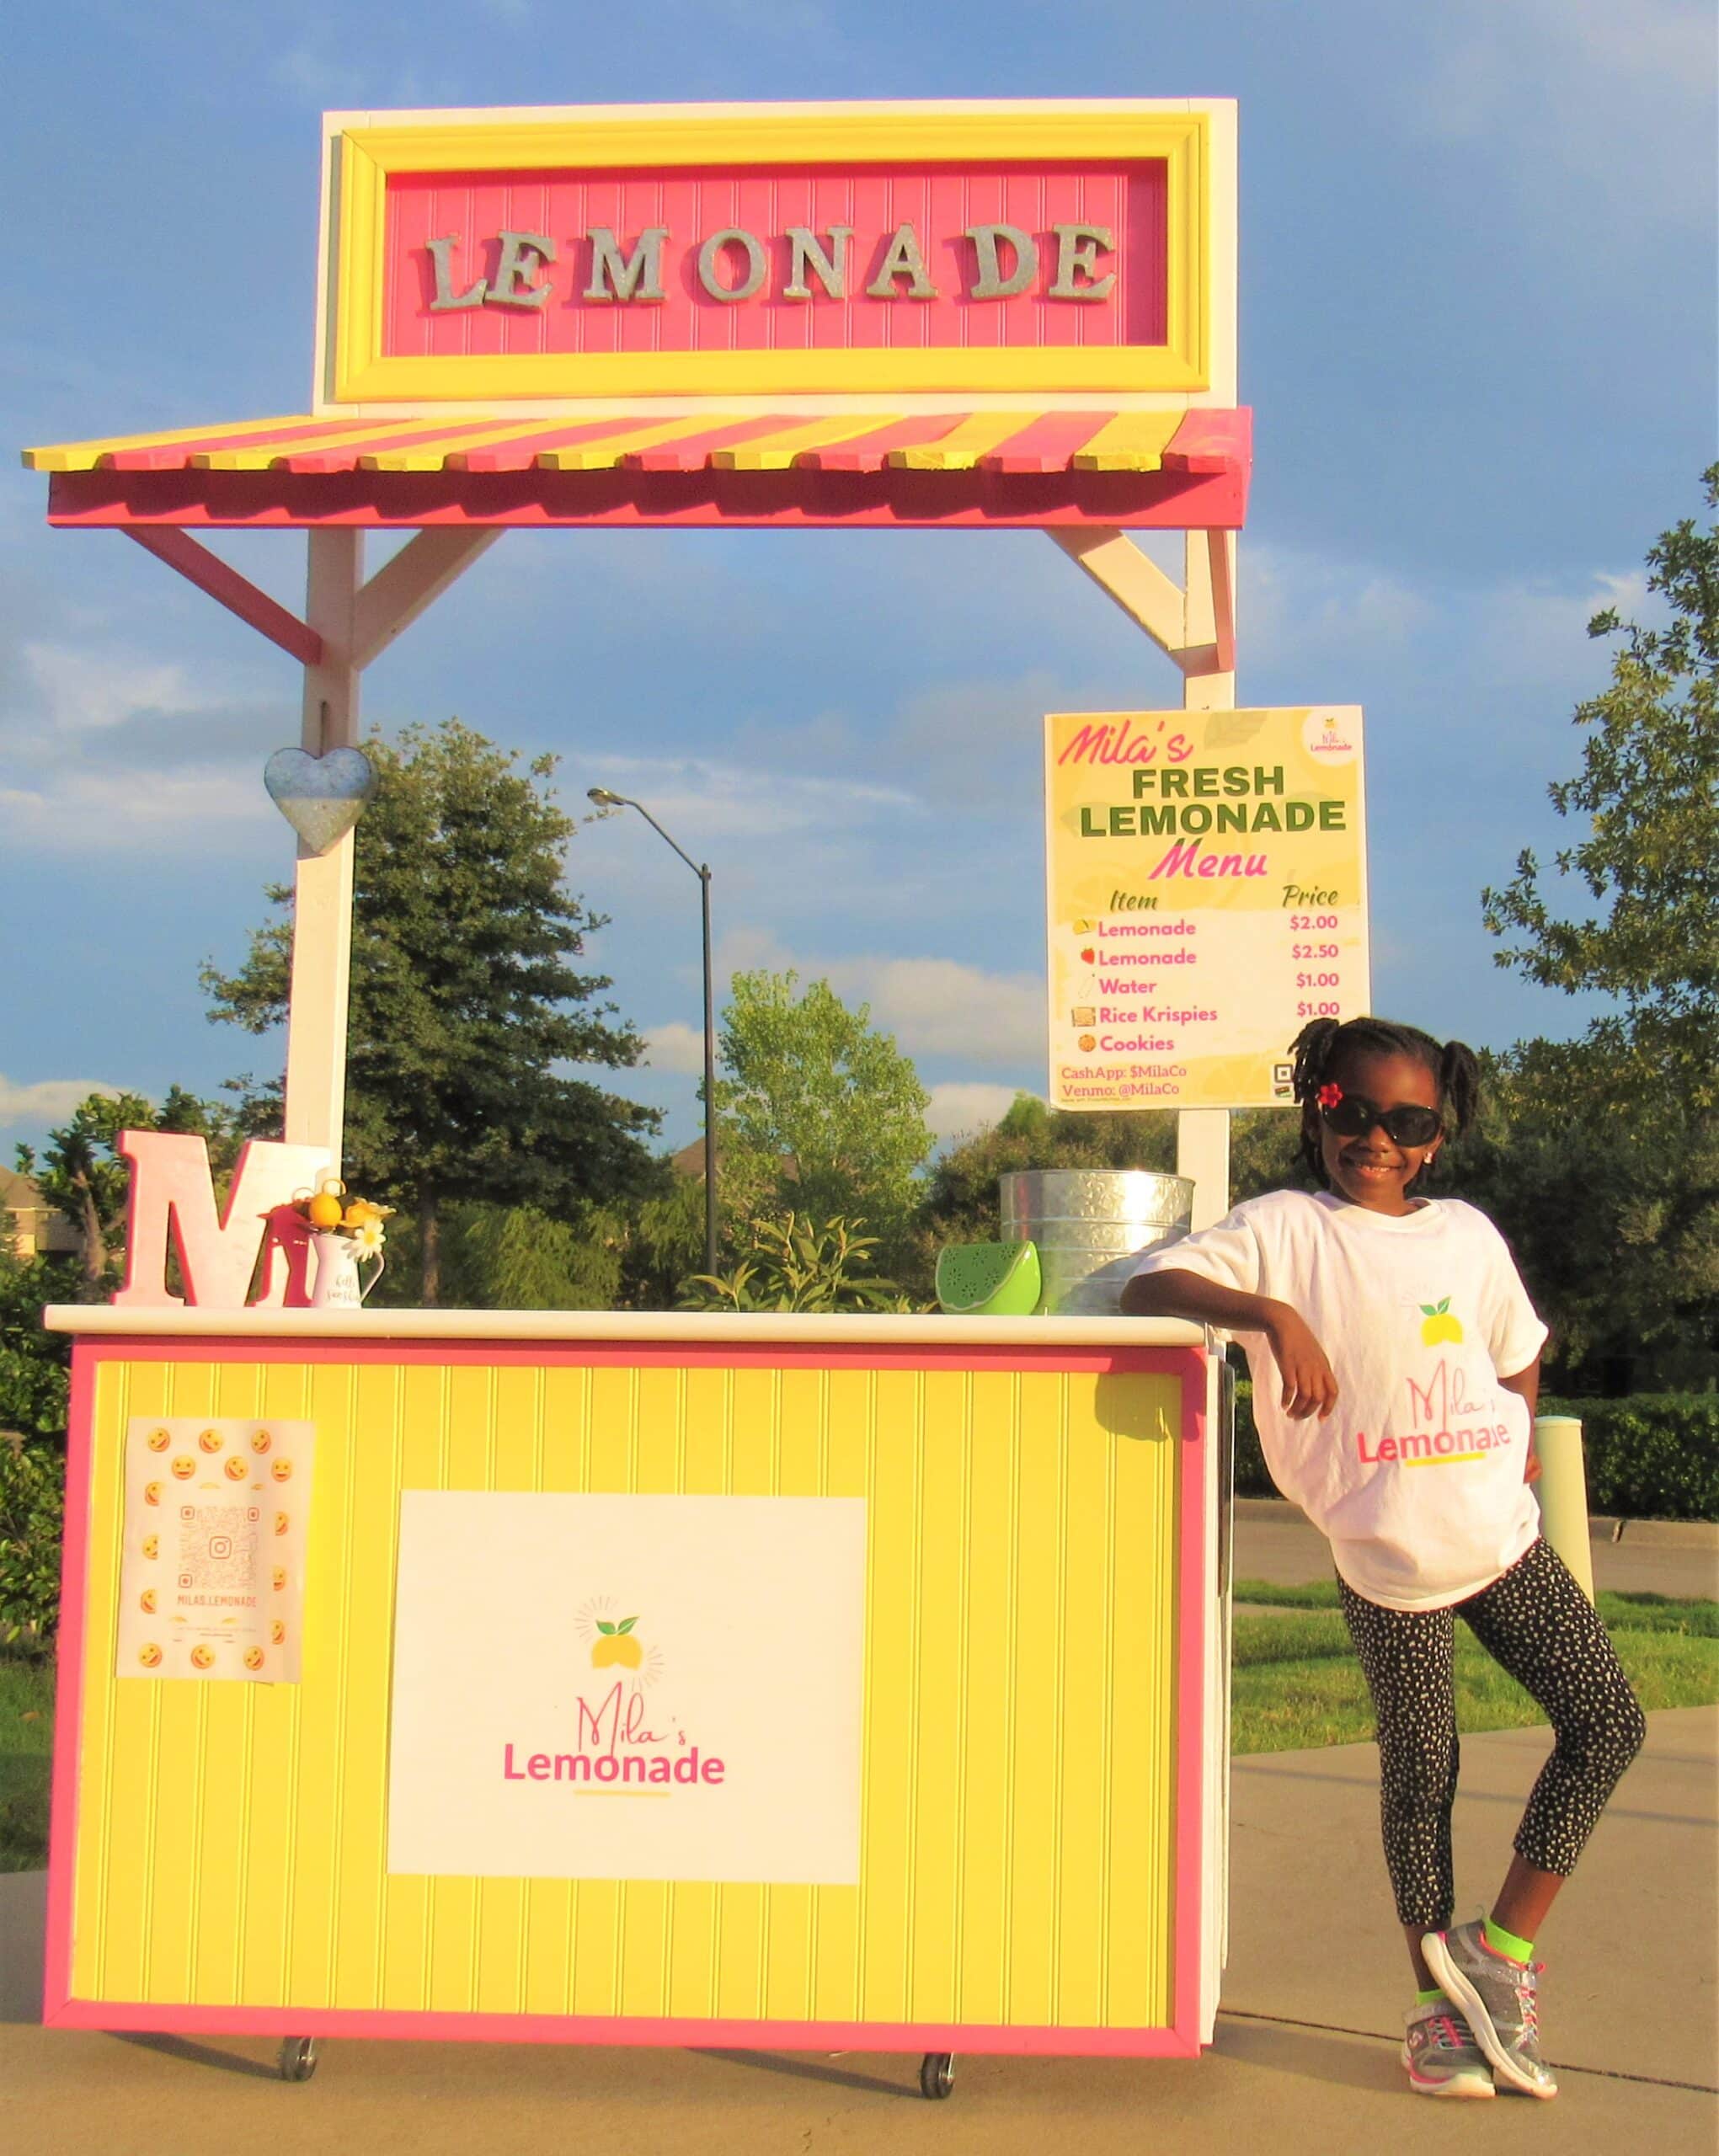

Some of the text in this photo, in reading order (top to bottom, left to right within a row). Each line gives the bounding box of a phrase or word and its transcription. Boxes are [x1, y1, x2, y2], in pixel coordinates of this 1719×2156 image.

[426, 222, 1116, 312] LEMONADE
[1058, 718, 1194, 766] Mila's
[1133, 766, 1284, 799] FRESH
[1081, 801, 1347, 837] LEMONADE
[1147, 837, 1268, 880] Menu
[1109, 889, 1159, 912] Item
[1282, 884, 1339, 908] Price
[1098, 918, 1197, 937] Lemonade
[1289, 914, 1338, 931] $2.00
[1099, 947, 1197, 966] Lemonade
[1292, 944, 1339, 960] $2.50
[1099, 978, 1157, 995] Water
[1296, 972, 1340, 989] $1.00
[1100, 1005, 1218, 1026] Rice Krispies
[1297, 1001, 1340, 1017] $1.00
[1100, 1034, 1175, 1052] Cookies
[1129, 1065, 1187, 1079] $MilaCo
[1062, 1082, 1180, 1097] Venmo: @MilaCo
[576, 1681, 686, 1757] Mila's
[504, 1743, 725, 1785] Lemonade
